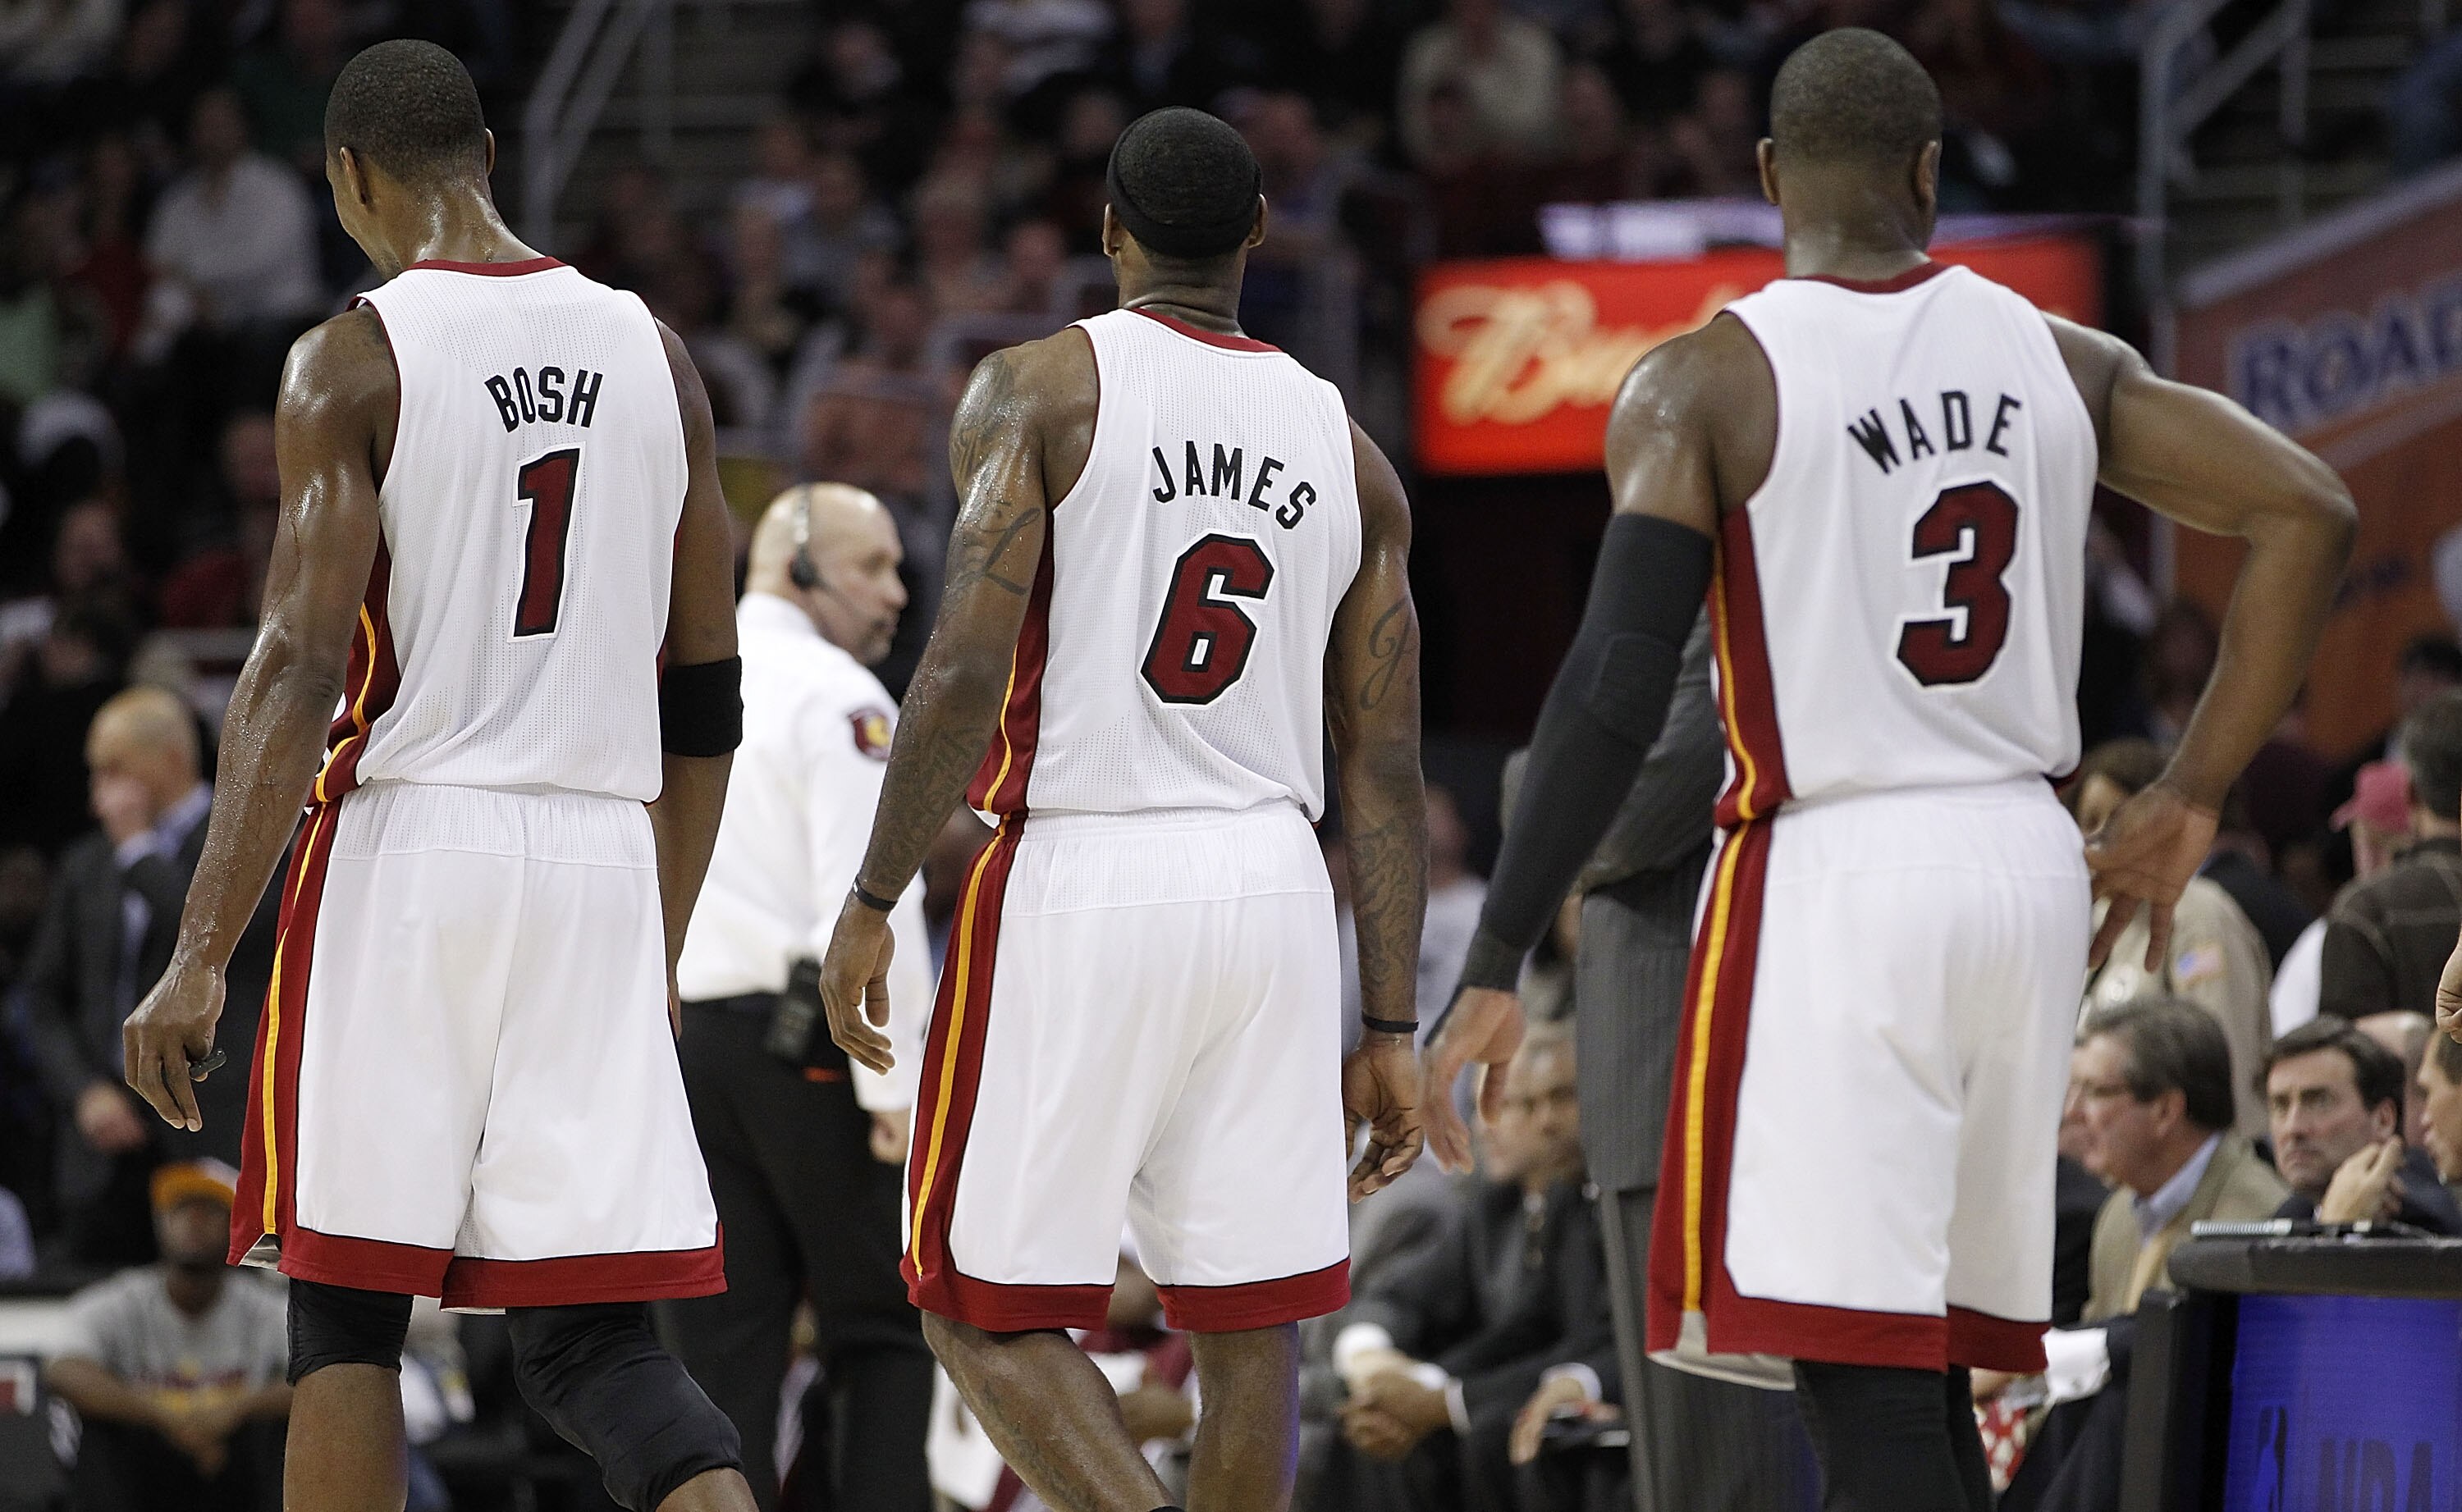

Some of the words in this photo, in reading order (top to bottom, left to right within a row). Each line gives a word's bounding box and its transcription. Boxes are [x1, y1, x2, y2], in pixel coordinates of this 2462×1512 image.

[484, 366, 603, 433] BOSH
[1846, 390, 2022, 475] WADE
[512, 446, 582, 638] 1
[1152, 441, 1316, 529] JAMES
[1140, 532, 1275, 706] 6
[1896, 480, 2020, 687] 3
